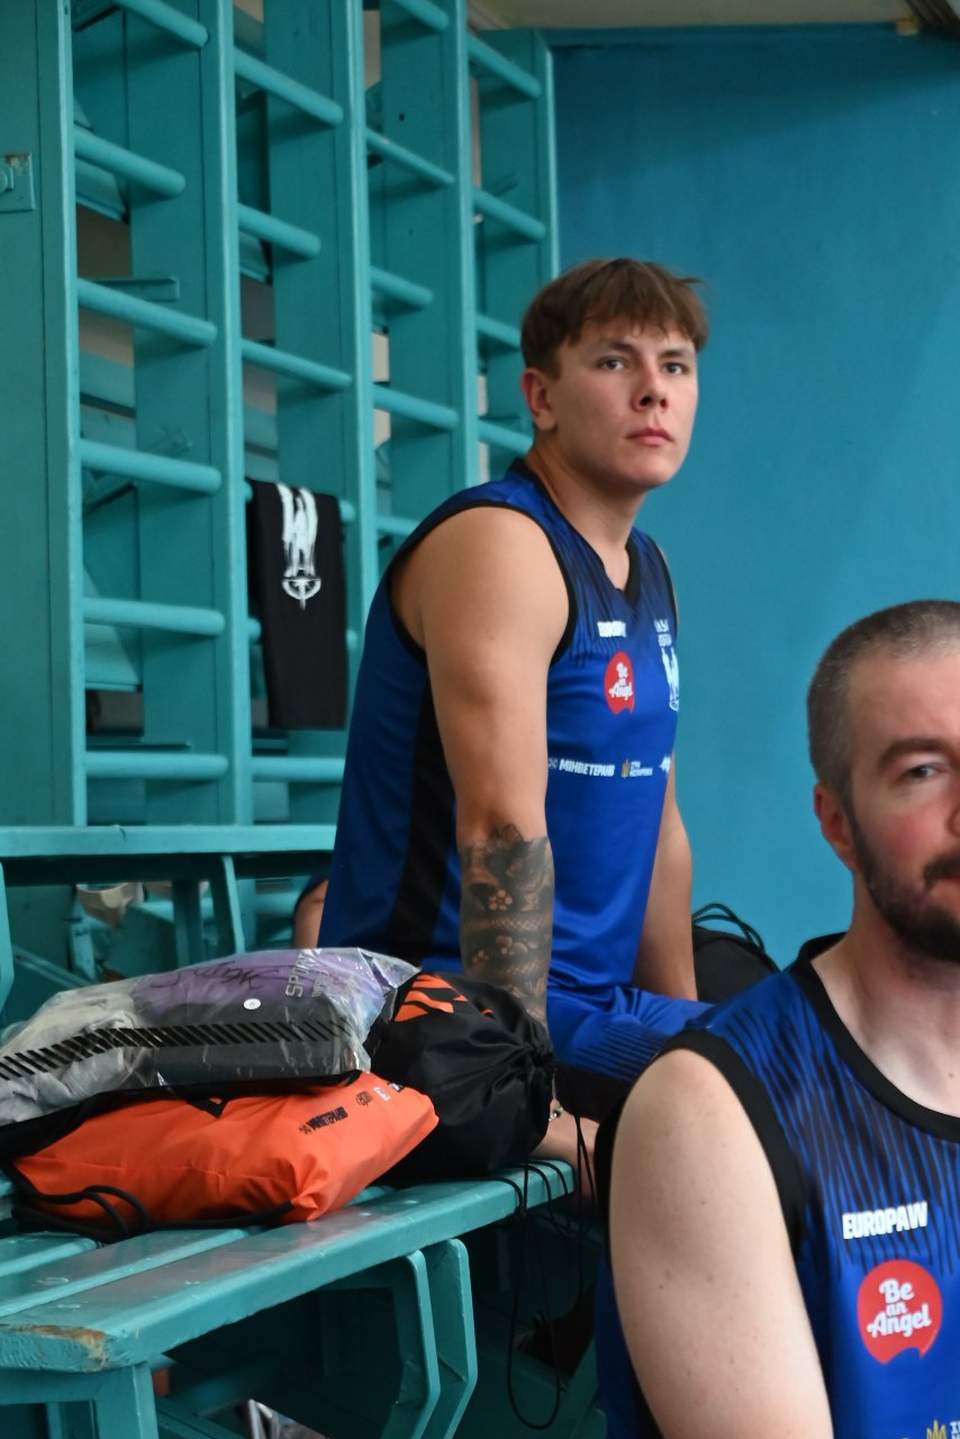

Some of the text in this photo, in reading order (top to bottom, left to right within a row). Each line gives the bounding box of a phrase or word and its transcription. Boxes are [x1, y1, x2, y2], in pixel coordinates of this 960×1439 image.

[842, 1200, 928, 1240] EUROPAW
[879, 1278, 915, 1303] Be
[866, 1303, 933, 1338] Angel
[885, 1301, 908, 1317] an
